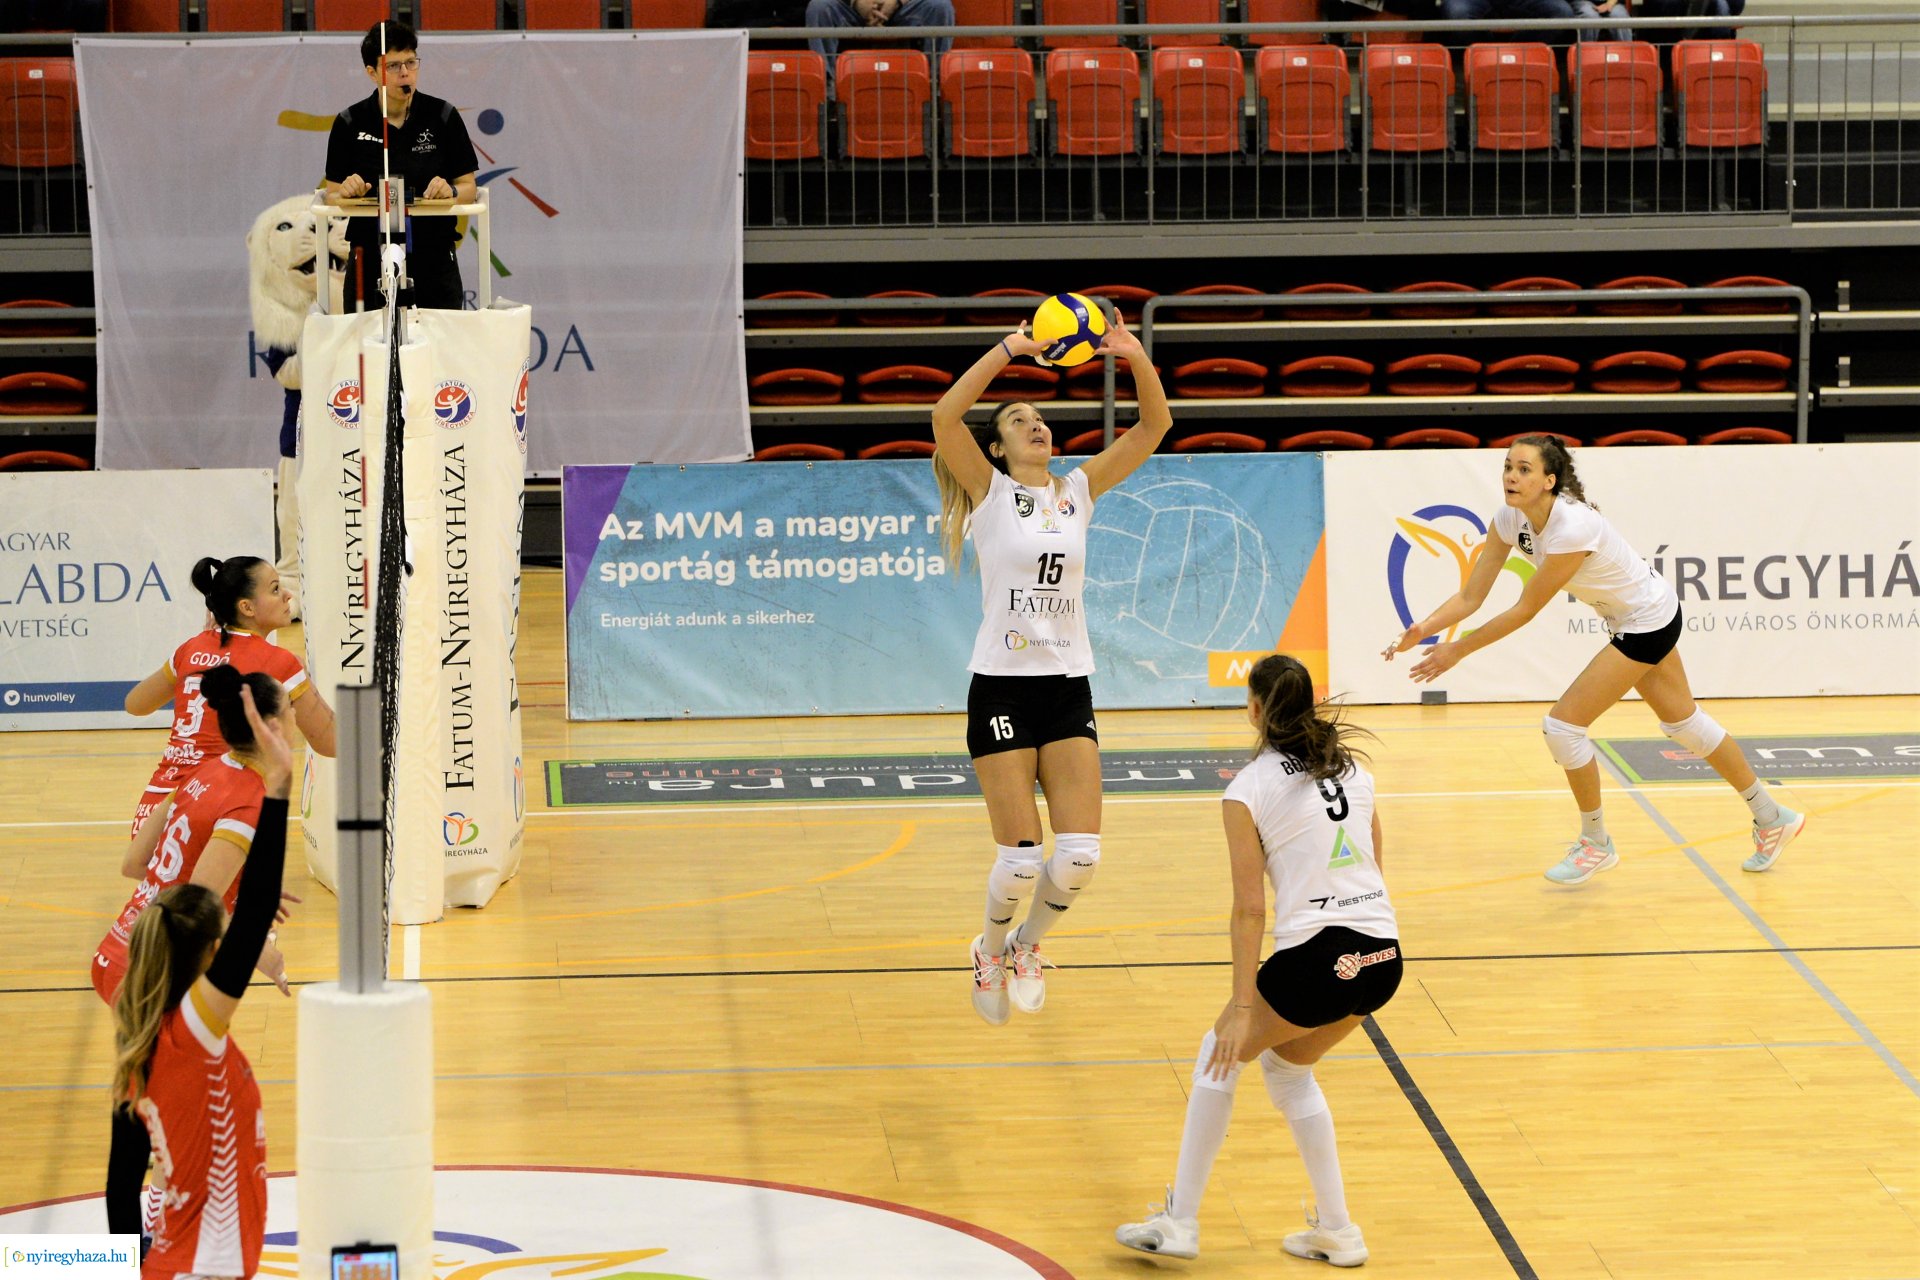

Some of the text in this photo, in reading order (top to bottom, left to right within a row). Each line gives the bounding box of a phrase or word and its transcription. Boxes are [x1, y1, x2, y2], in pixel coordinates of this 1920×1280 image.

[339, 380, 360, 389] FATU
[440, 380, 465, 389] FATUM
[329, 410, 360, 429] NYÍREGY
[434, 410, 476, 430] YÍREGYHÁZA
[599, 513, 644, 540] Az
[655, 511, 743, 540] MVM
[755, 517, 774, 538] a
[786, 514, 916, 542] magyar
[0, 532, 71, 551] GYAR
[600, 547, 946, 588] sportág támogatója
[1037, 553, 1066, 585] 15
[1008, 587, 1075, 614] FATUM
[0, 614, 89, 638] VETSÉG
[601, 610, 815, 630] Energiát adunk a sikerhez
[1726, 612, 1797, 632] VÁROS
[1806, 610, 1920, 631] ÖNKORMÁ
[23, 692, 76, 703] hunvolley
[174, 676, 206, 738] 3
[989, 715, 1014, 741] 15
[1315, 777, 1349, 822] 9
[445, 847, 488, 857] ÍREGYHÁZA
[1337, 890, 1383, 907] BESTRONG
